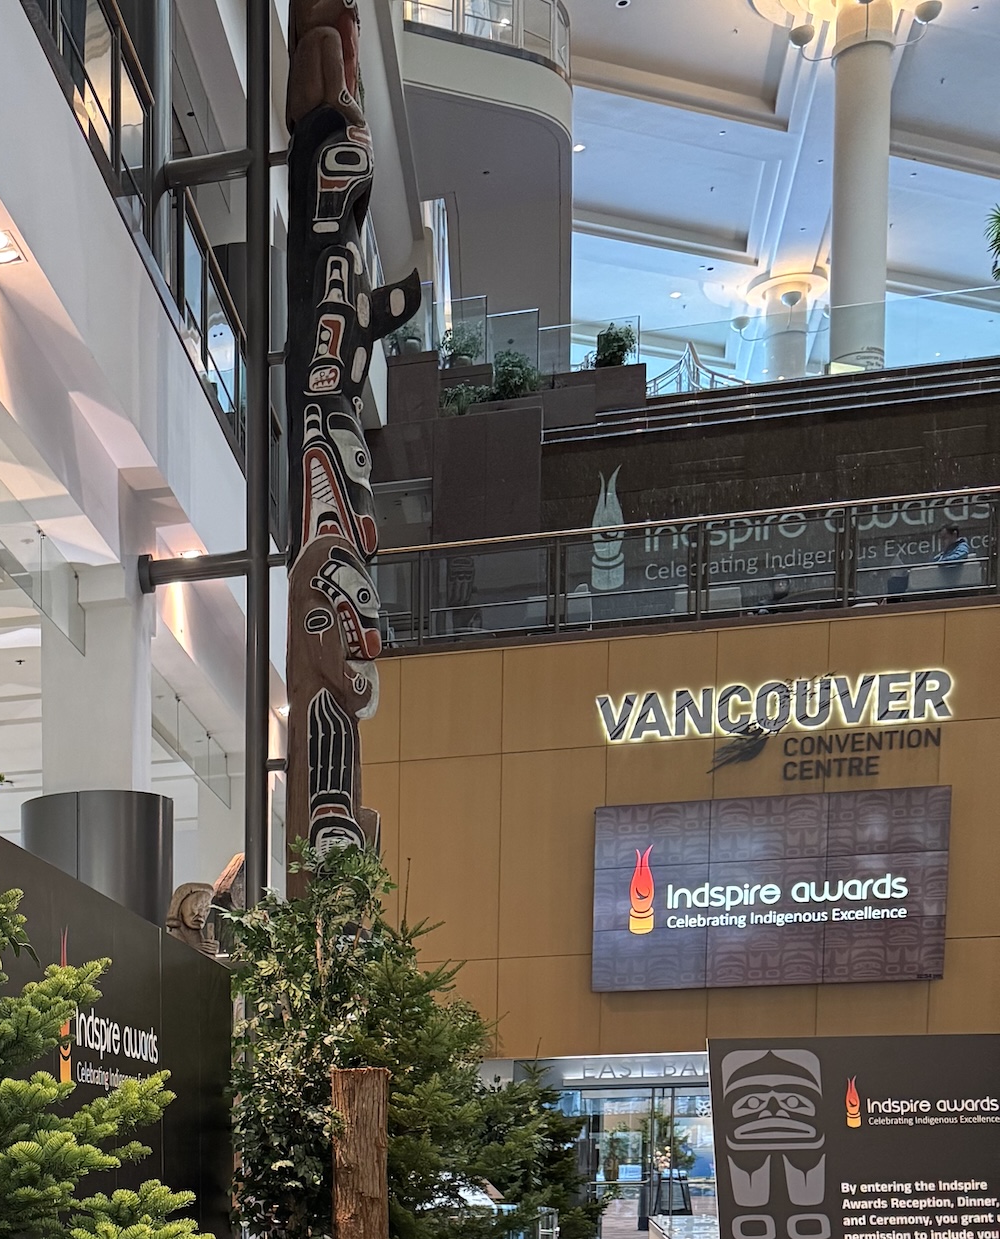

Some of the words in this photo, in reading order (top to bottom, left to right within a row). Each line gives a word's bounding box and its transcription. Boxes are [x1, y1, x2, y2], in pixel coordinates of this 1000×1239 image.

[884, 534, 989, 558] Excellce
[596, 669, 953, 742] VANCOUVER
[783, 727, 942, 758] CONVENTION
[782, 755, 880, 782] CENTRE
[667, 882, 781, 911] Indspire
[791, 873, 908, 904] awards
[667, 912, 747, 929] Celebrating
[750, 908, 828, 927] Indigenous
[832, 905, 908, 922] Excellence
[76, 1006, 121, 1060] Indspire
[123, 1026, 159, 1065] awards
[77, 1061, 110, 1091] Celebrating
[582, 1061, 650, 1079] EAST
[867, 1098, 931, 1115] Indspire
[936, 1096, 999, 1112] awards
[868, 1116, 914, 1126] Celebrating
[915, 1115, 958, 1126] Indigenous
[960, 1114, 1000, 1124] Excellence
[841, 1182, 856, 1195] By
[860, 1181, 912, 1194] entering
[915, 1180, 936, 1191] the
[938, 1179, 988, 1192] Indspire
[842, 1198, 888, 1209] Awards
[891, 1196, 954, 1210] Reception,
[957, 1195, 1000, 1208] Dinner,
[843, 1215, 866, 1226] and
[869, 1214, 933, 1226] Ceremony,
[935, 1215, 958, 1226] you
[961, 1212, 994, 1226] grant
[930, 1229, 974, 1239] include
